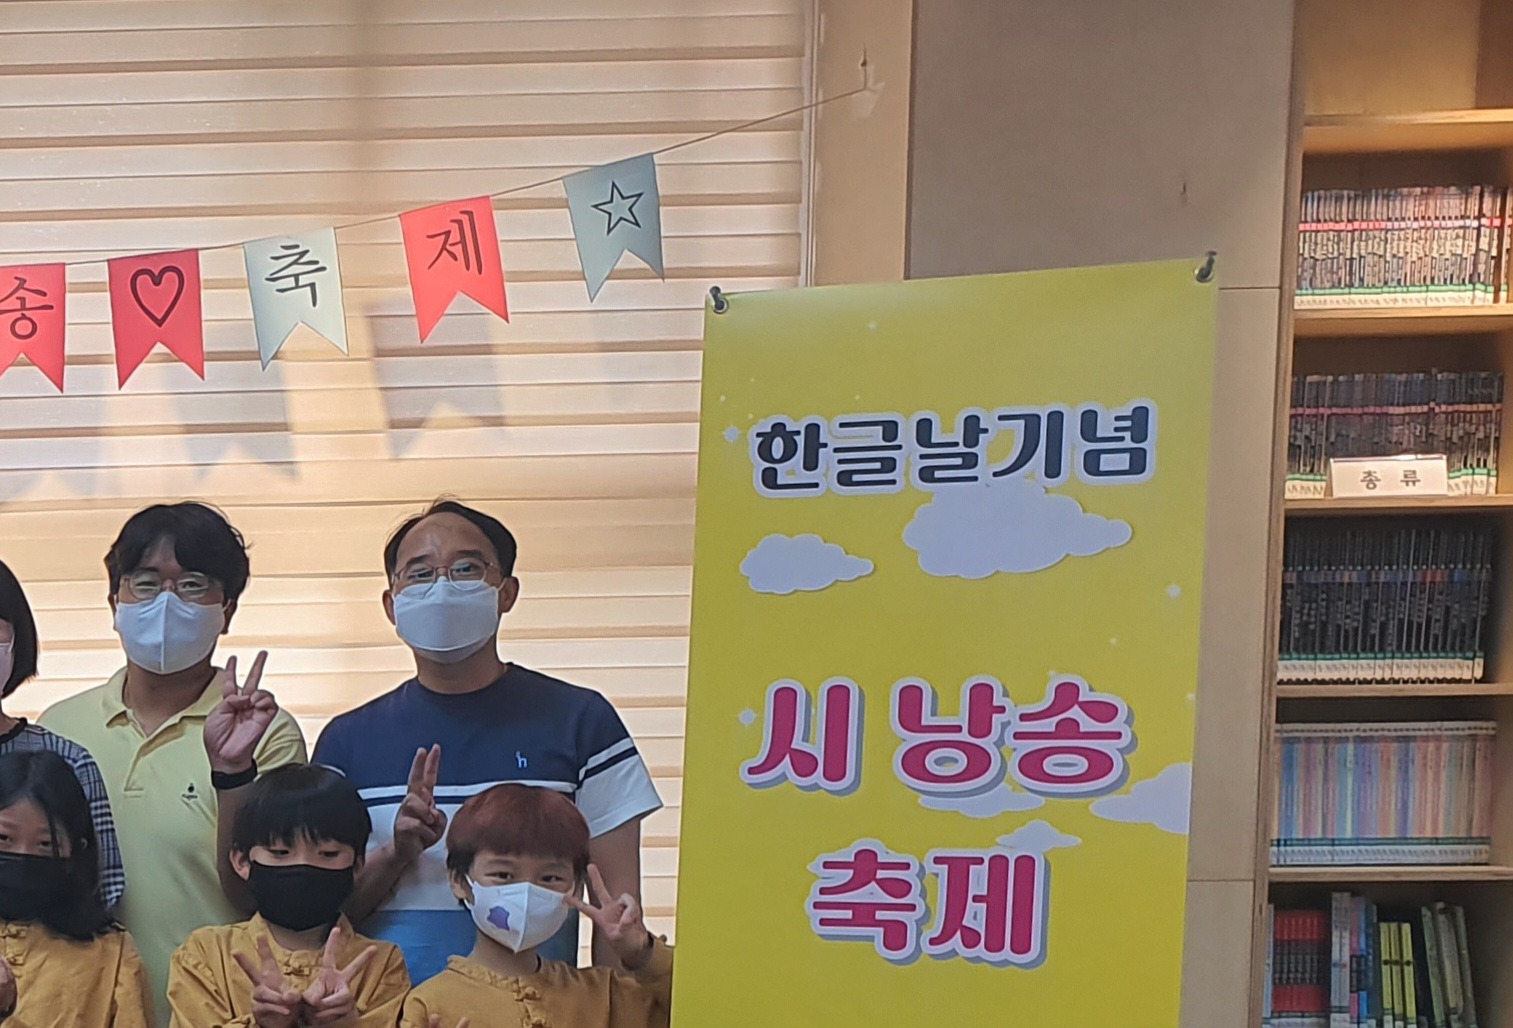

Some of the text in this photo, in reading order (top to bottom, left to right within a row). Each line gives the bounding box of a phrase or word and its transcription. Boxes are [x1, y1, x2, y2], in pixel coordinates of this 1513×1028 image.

[744, 678, 1130, 790] 시 낭송
[810, 846, 1041, 960] 축제
